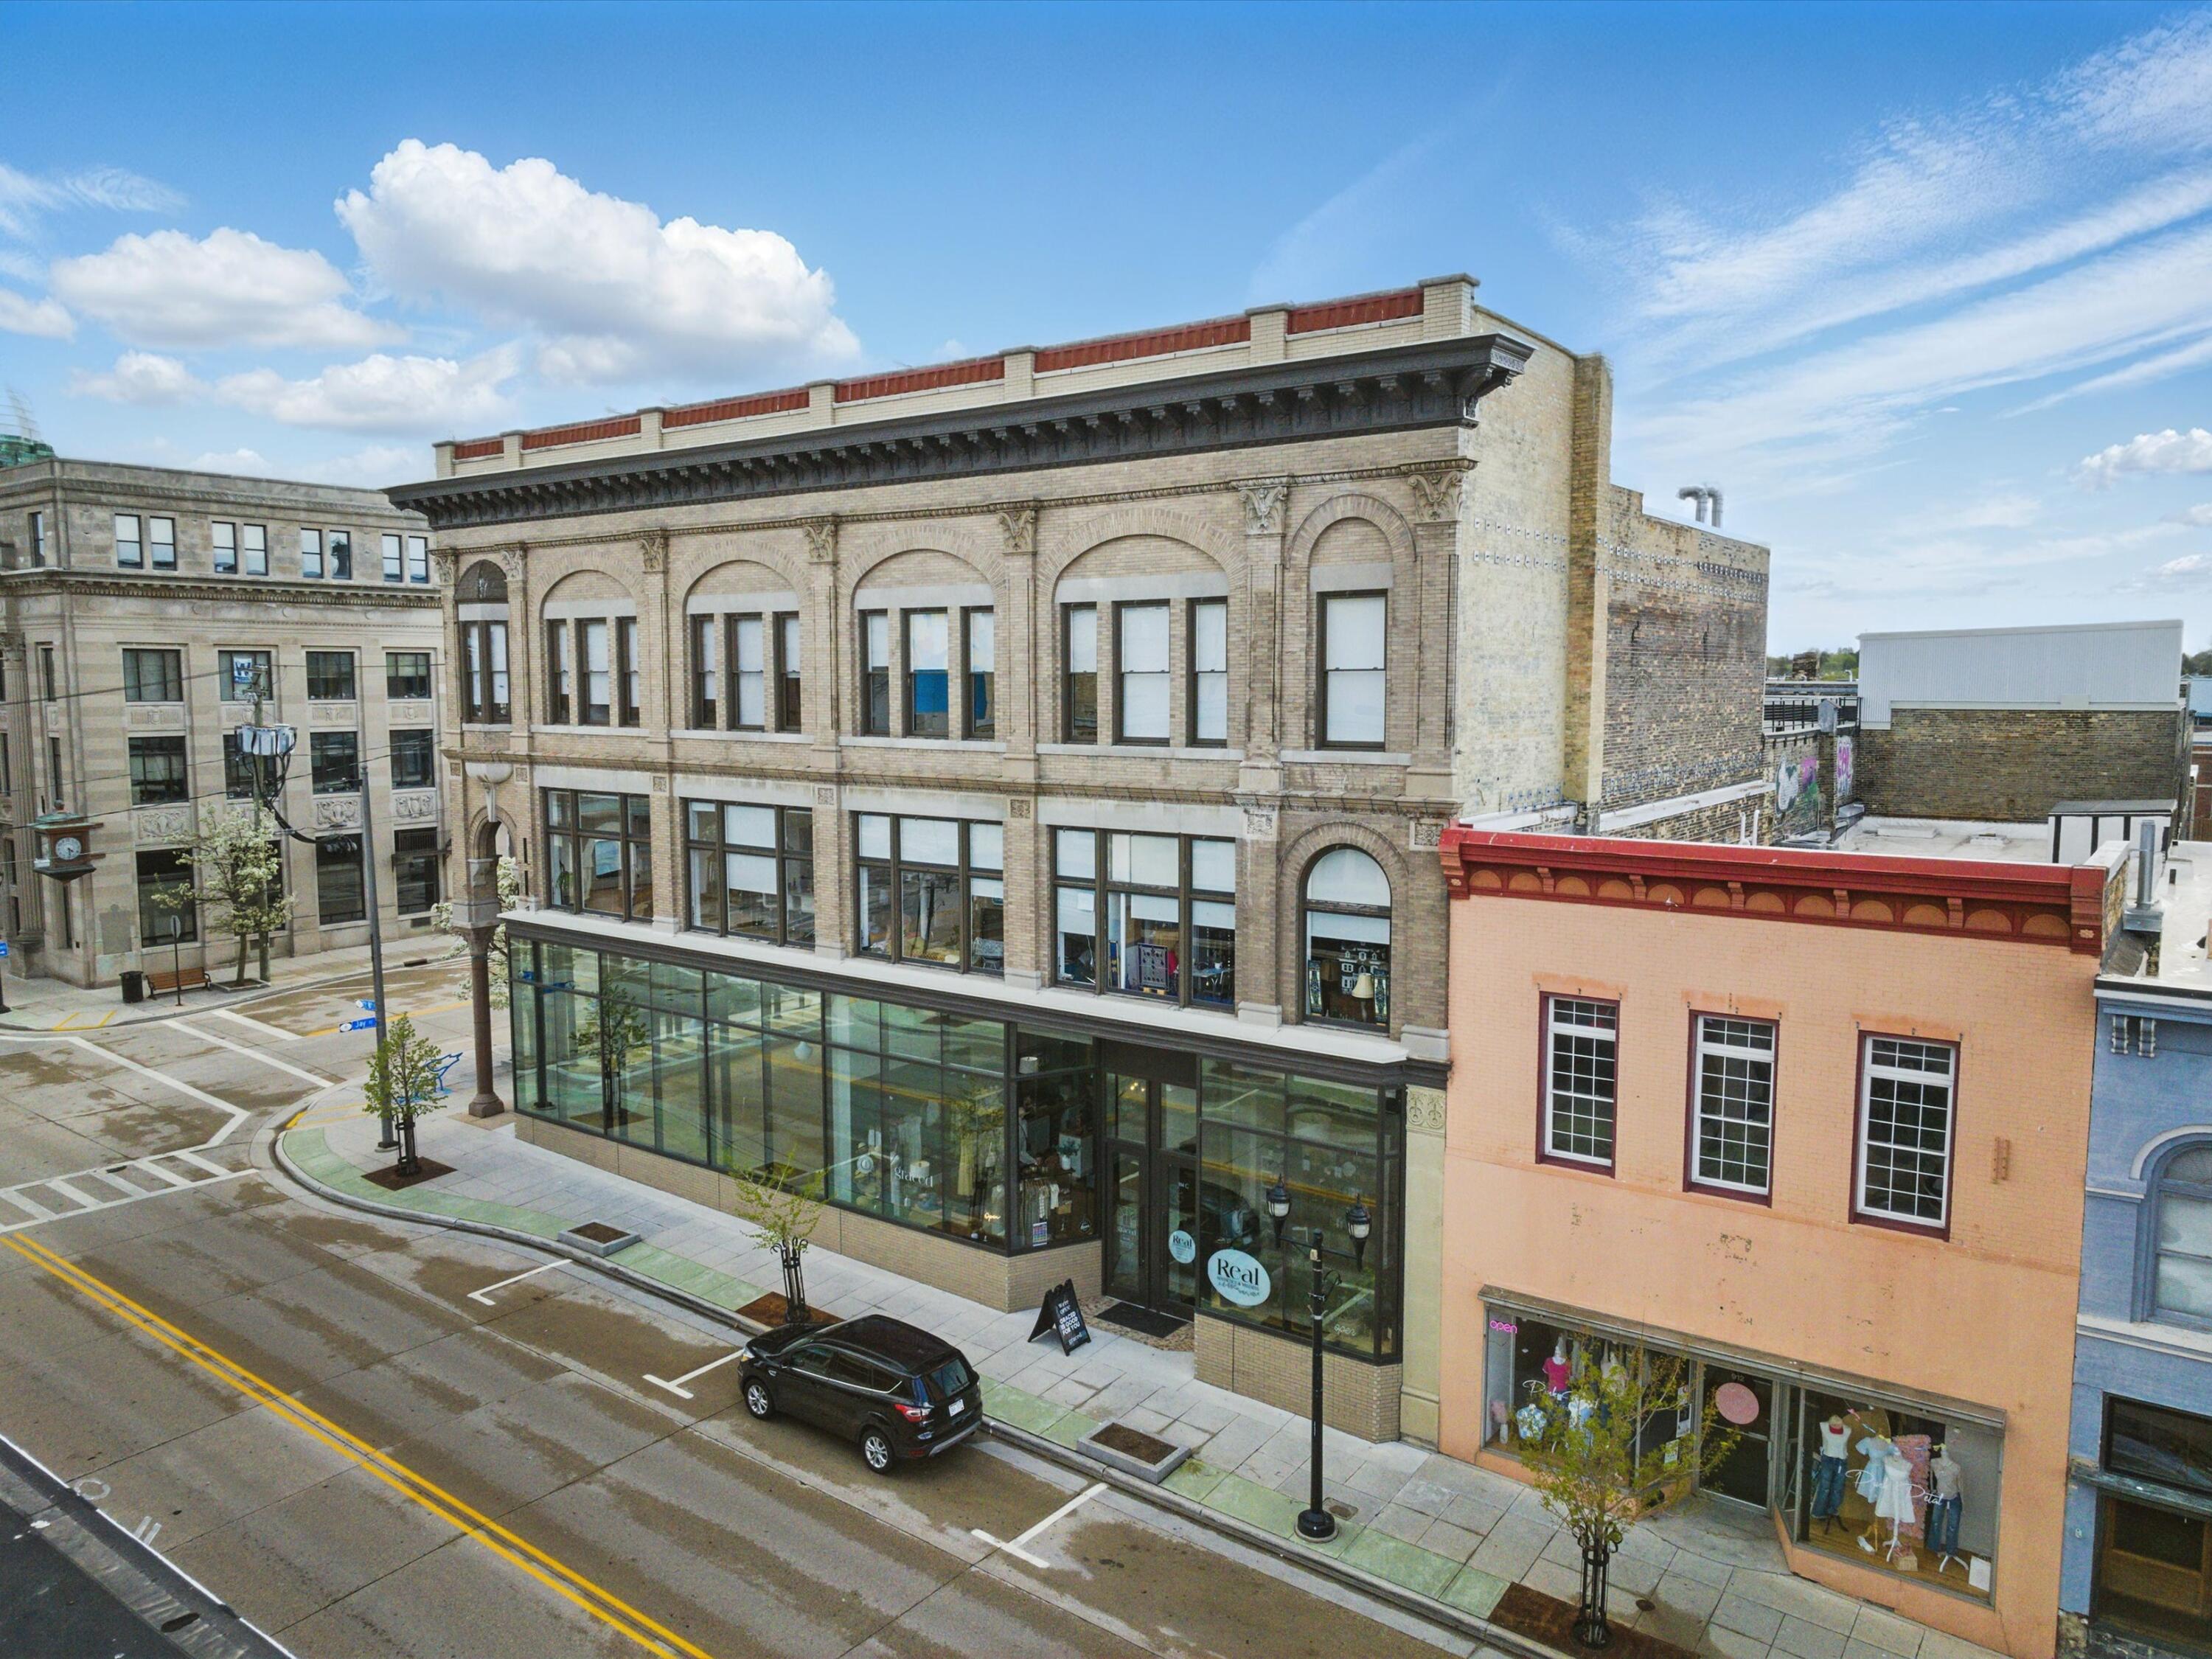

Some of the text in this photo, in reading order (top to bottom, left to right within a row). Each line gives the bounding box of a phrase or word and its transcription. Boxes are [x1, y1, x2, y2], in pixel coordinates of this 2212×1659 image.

[355, 1020, 366, 1029] Jay
[894, 1166, 933, 1188] graced
[984, 1211, 1001, 1222] Open
[1173, 1235, 1192, 1248] Real
[1217, 1258, 1259, 1285] Real
[1060, 1311, 1077, 1324] GRACED
[1065, 1316, 1078, 1328] GOOD
[1062, 1321, 1080, 1336] FOR YOU
[1489, 1320, 1517, 1334] open
[1731, 1373, 1745, 1382] 912
